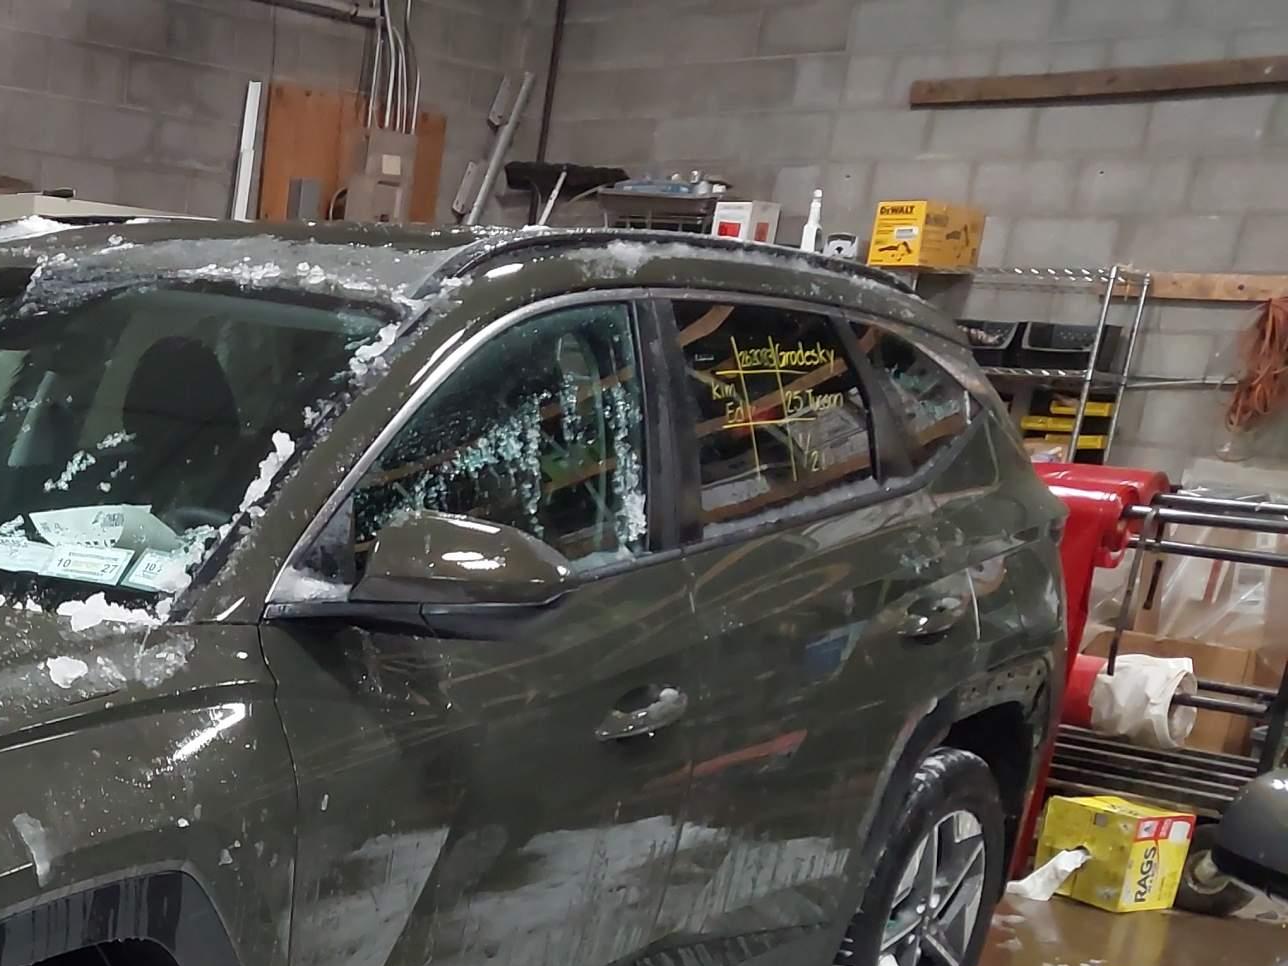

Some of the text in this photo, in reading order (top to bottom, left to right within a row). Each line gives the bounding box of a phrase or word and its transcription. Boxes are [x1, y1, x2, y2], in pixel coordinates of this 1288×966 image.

[785, 390, 804, 413] 25
[56, 558, 119, 574] 10 27
[144, 562, 157, 571] 10
[1134, 846, 1157, 903] RAGS
